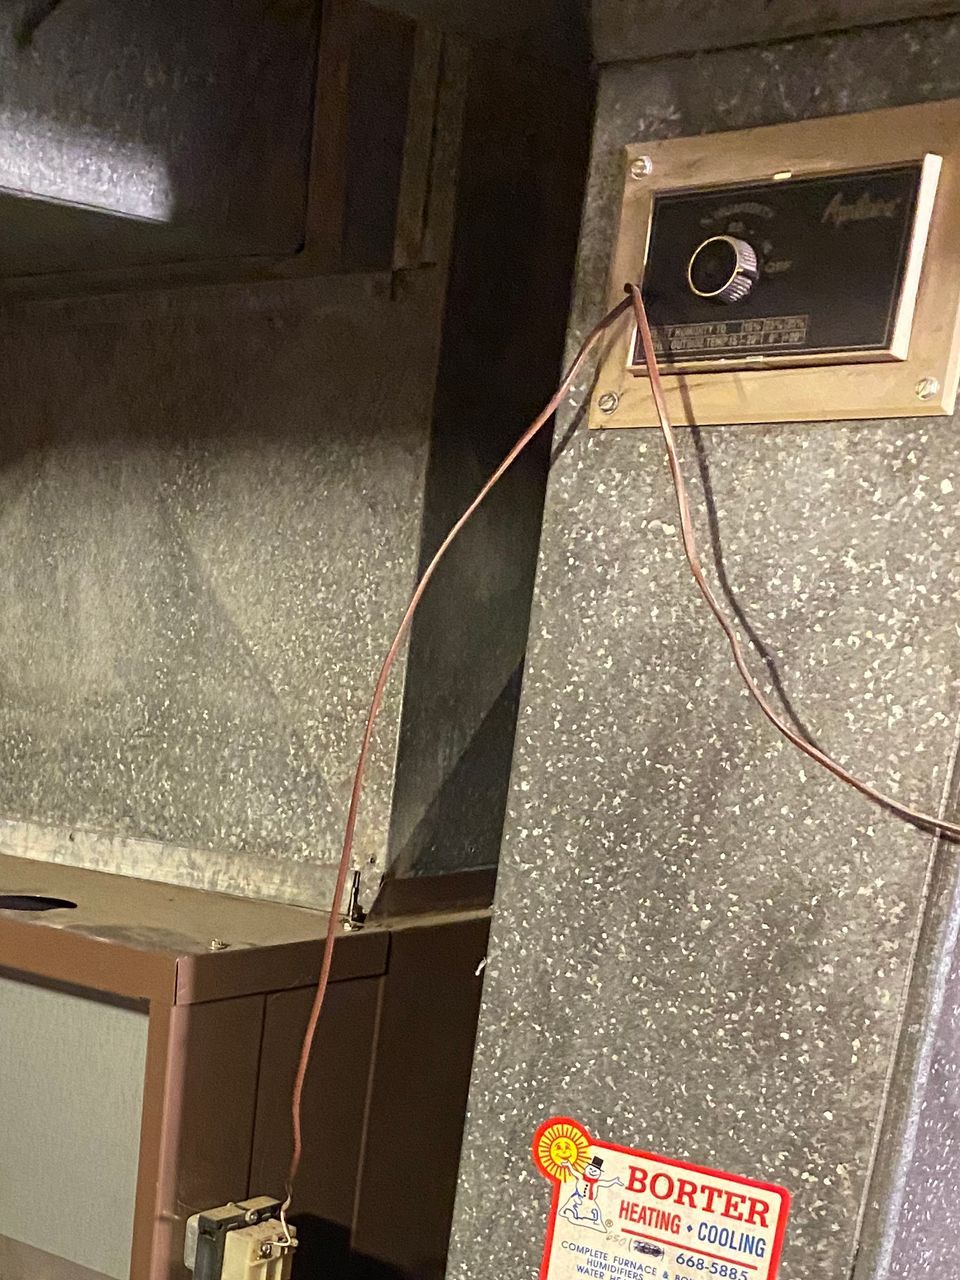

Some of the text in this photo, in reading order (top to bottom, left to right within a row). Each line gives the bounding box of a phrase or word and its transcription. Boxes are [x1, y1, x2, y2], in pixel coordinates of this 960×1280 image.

[625, 1165, 771, 1229] BORTER
[619, 1200, 682, 1235] HEATING
[697, 1222, 767, 1258] COOLING
[561, 1240, 608, 1261] COMPLETE
[613, 1255, 657, 1276] FURNACE
[662, 1271, 669, 1279] &
[576, 1264, 605, 1280] WATER
